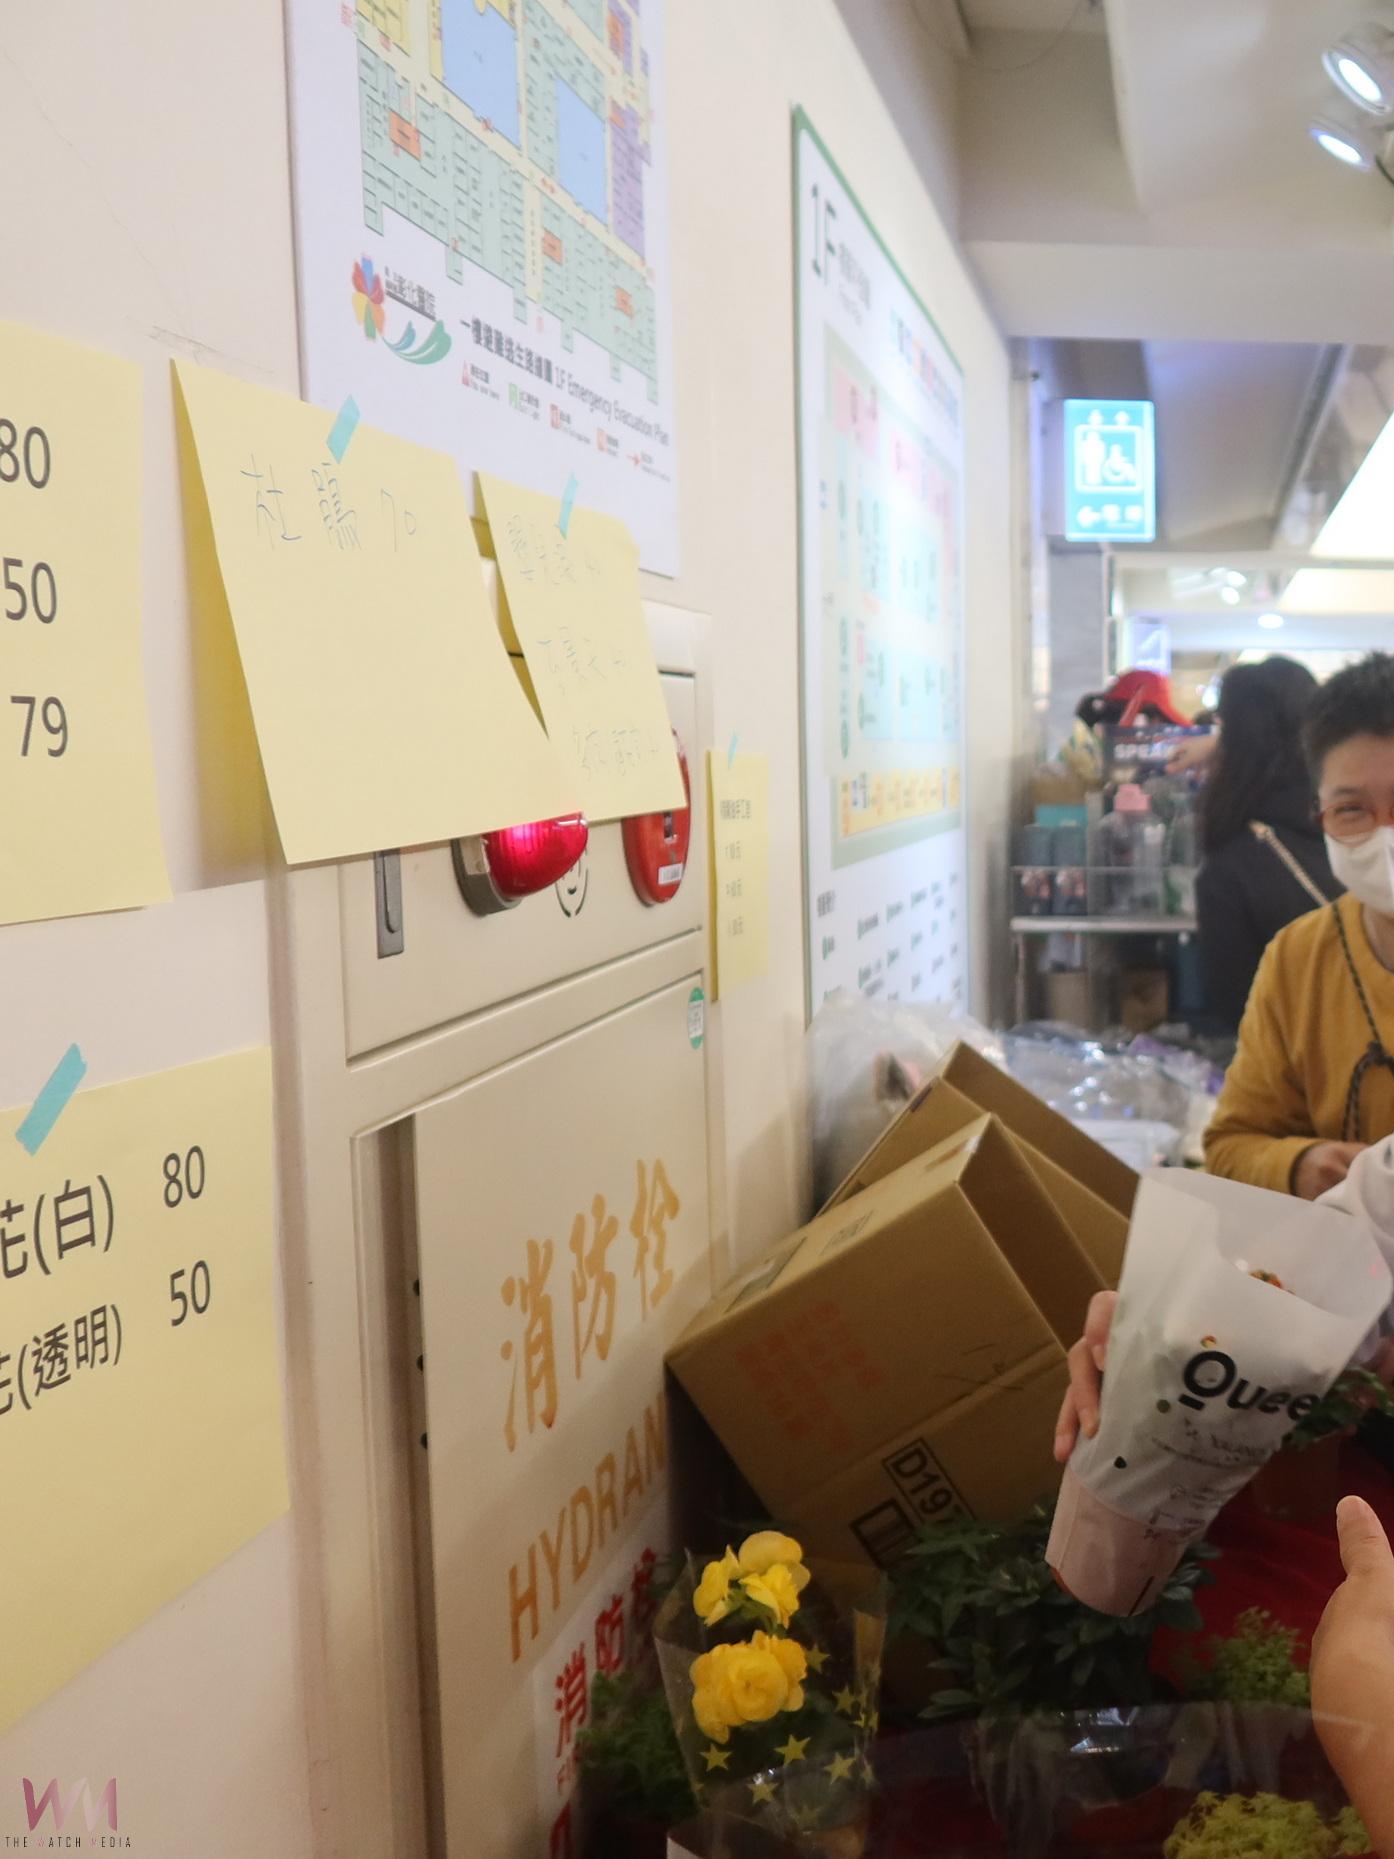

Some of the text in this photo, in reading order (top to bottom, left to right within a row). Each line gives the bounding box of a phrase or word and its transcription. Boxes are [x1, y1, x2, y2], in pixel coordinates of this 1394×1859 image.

[567, 370, 612, 421] Emergency
[0, 419, 51, 490] 80
[2, 557, 58, 625] 50
[10, 696, 69, 758] 79
[162, 1145, 206, 1208] 80
[0, 1260, 211, 1415] (透明) 50
[500, 1158, 681, 1453] 消防栓
[508, 1392, 669, 1664] HYDRAN
